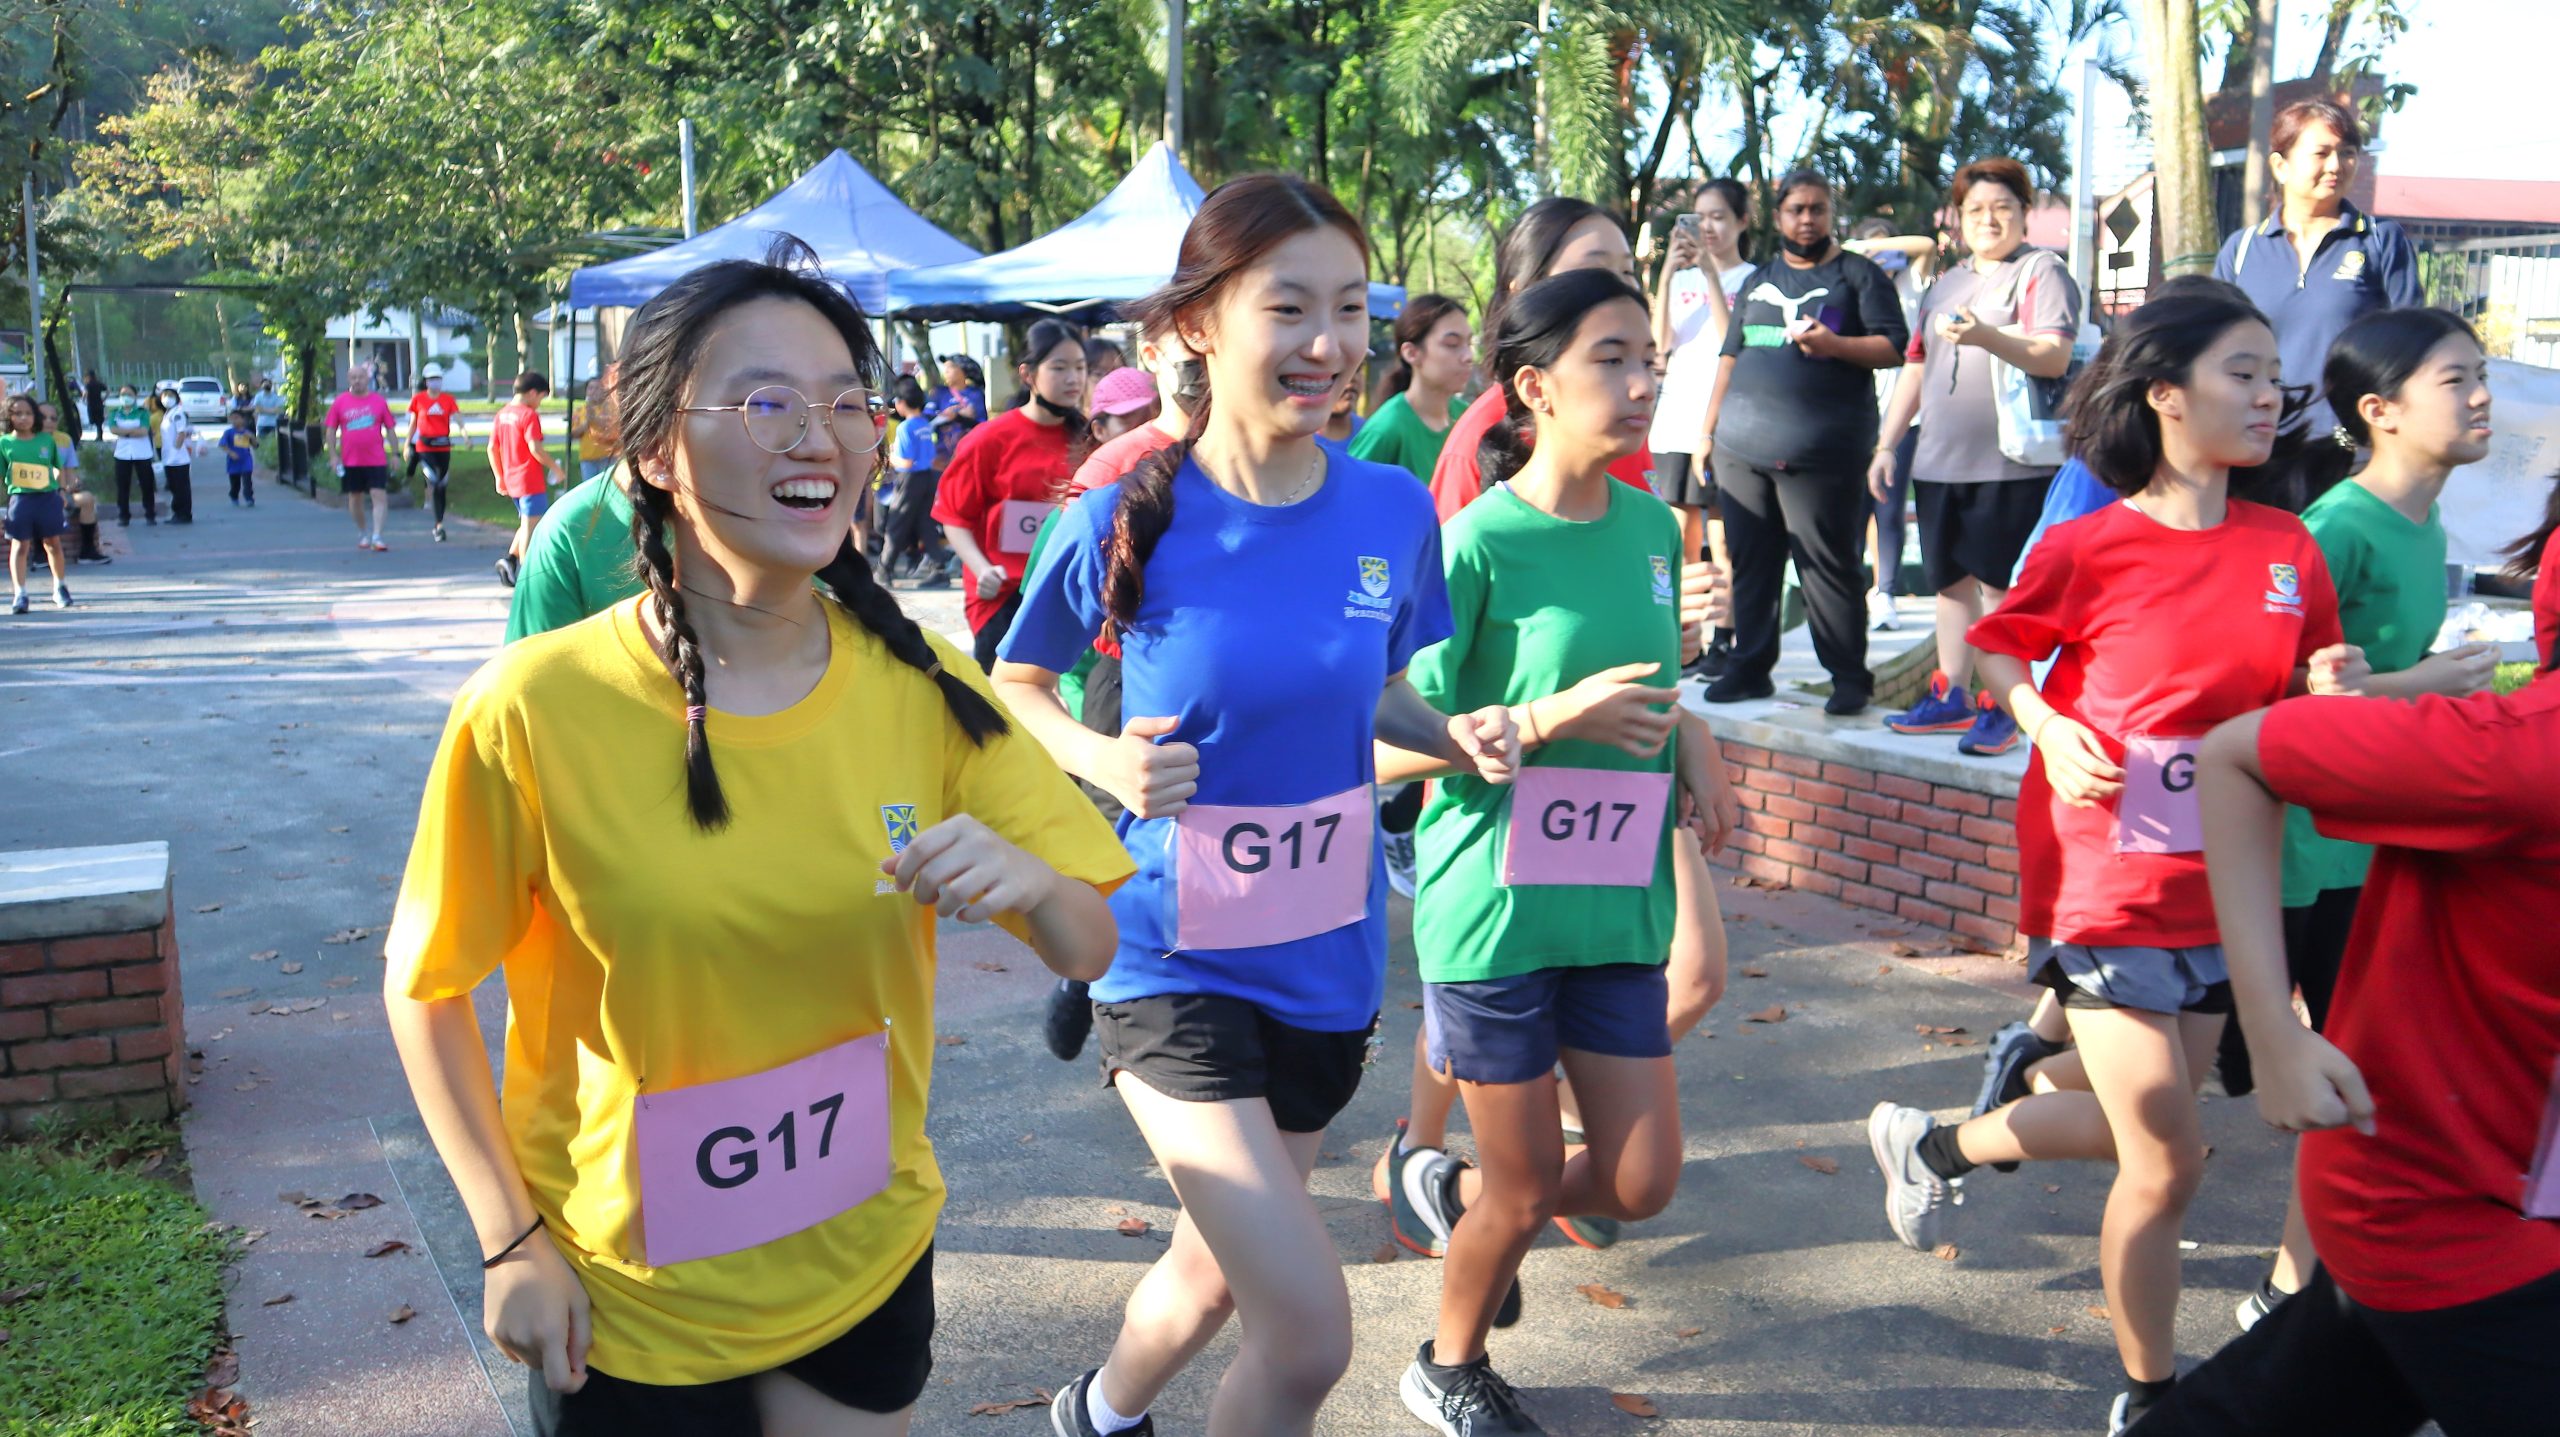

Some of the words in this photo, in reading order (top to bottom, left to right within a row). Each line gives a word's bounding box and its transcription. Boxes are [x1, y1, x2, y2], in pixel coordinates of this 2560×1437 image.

[19, 469, 42, 480] B12
[1019, 515, 1047, 534] G
[1541, 799, 1637, 842] G17
[1222, 811, 1342, 875] G17
[696, 1092, 844, 1189] G17
